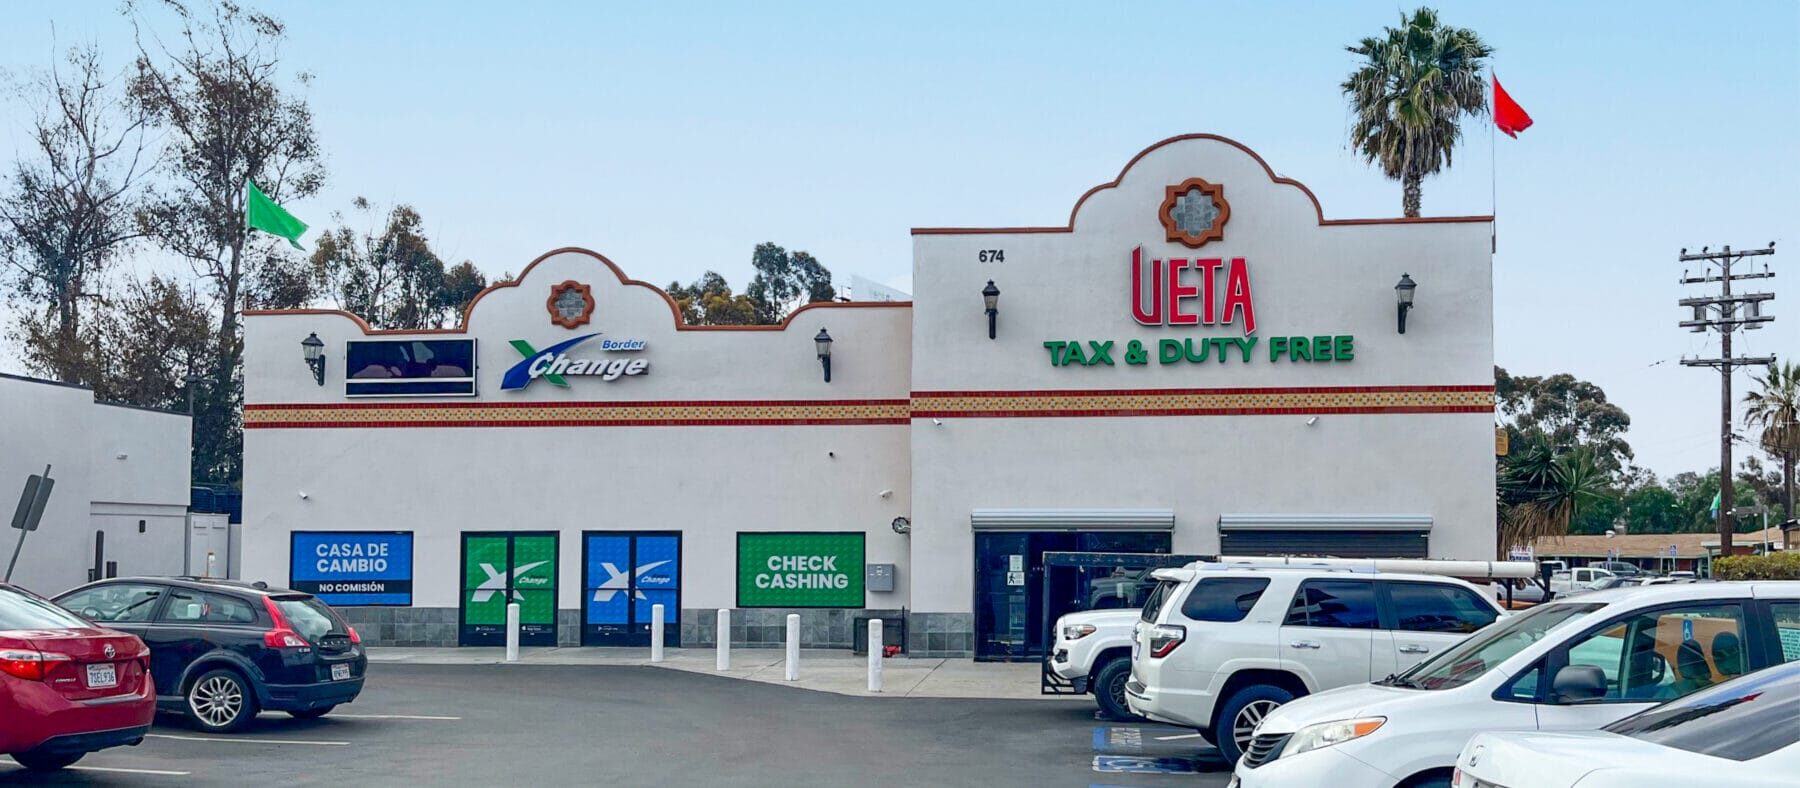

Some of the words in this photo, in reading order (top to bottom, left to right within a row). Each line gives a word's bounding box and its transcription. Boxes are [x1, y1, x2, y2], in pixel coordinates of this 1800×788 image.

[979, 249, 1005, 263] 674
[1130, 243, 1257, 337] UETA
[602, 340, 645, 351] Border
[1043, 340, 1114, 366] TAX
[1124, 339, 1148, 365] &
[1159, 336, 1258, 365] DUTY
[1270, 335, 1354, 362] FREE
[316, 543, 364, 557] CASA
[367, 543, 389, 557] DE
[316, 558, 388, 573] CAMBIO
[767, 555, 837, 571] CHECK
[319, 583, 334, 592] NO
[335, 581, 385, 592] COMISIÓN
[641, 576, 671, 585] Change
[755, 573, 849, 589] CASHING
